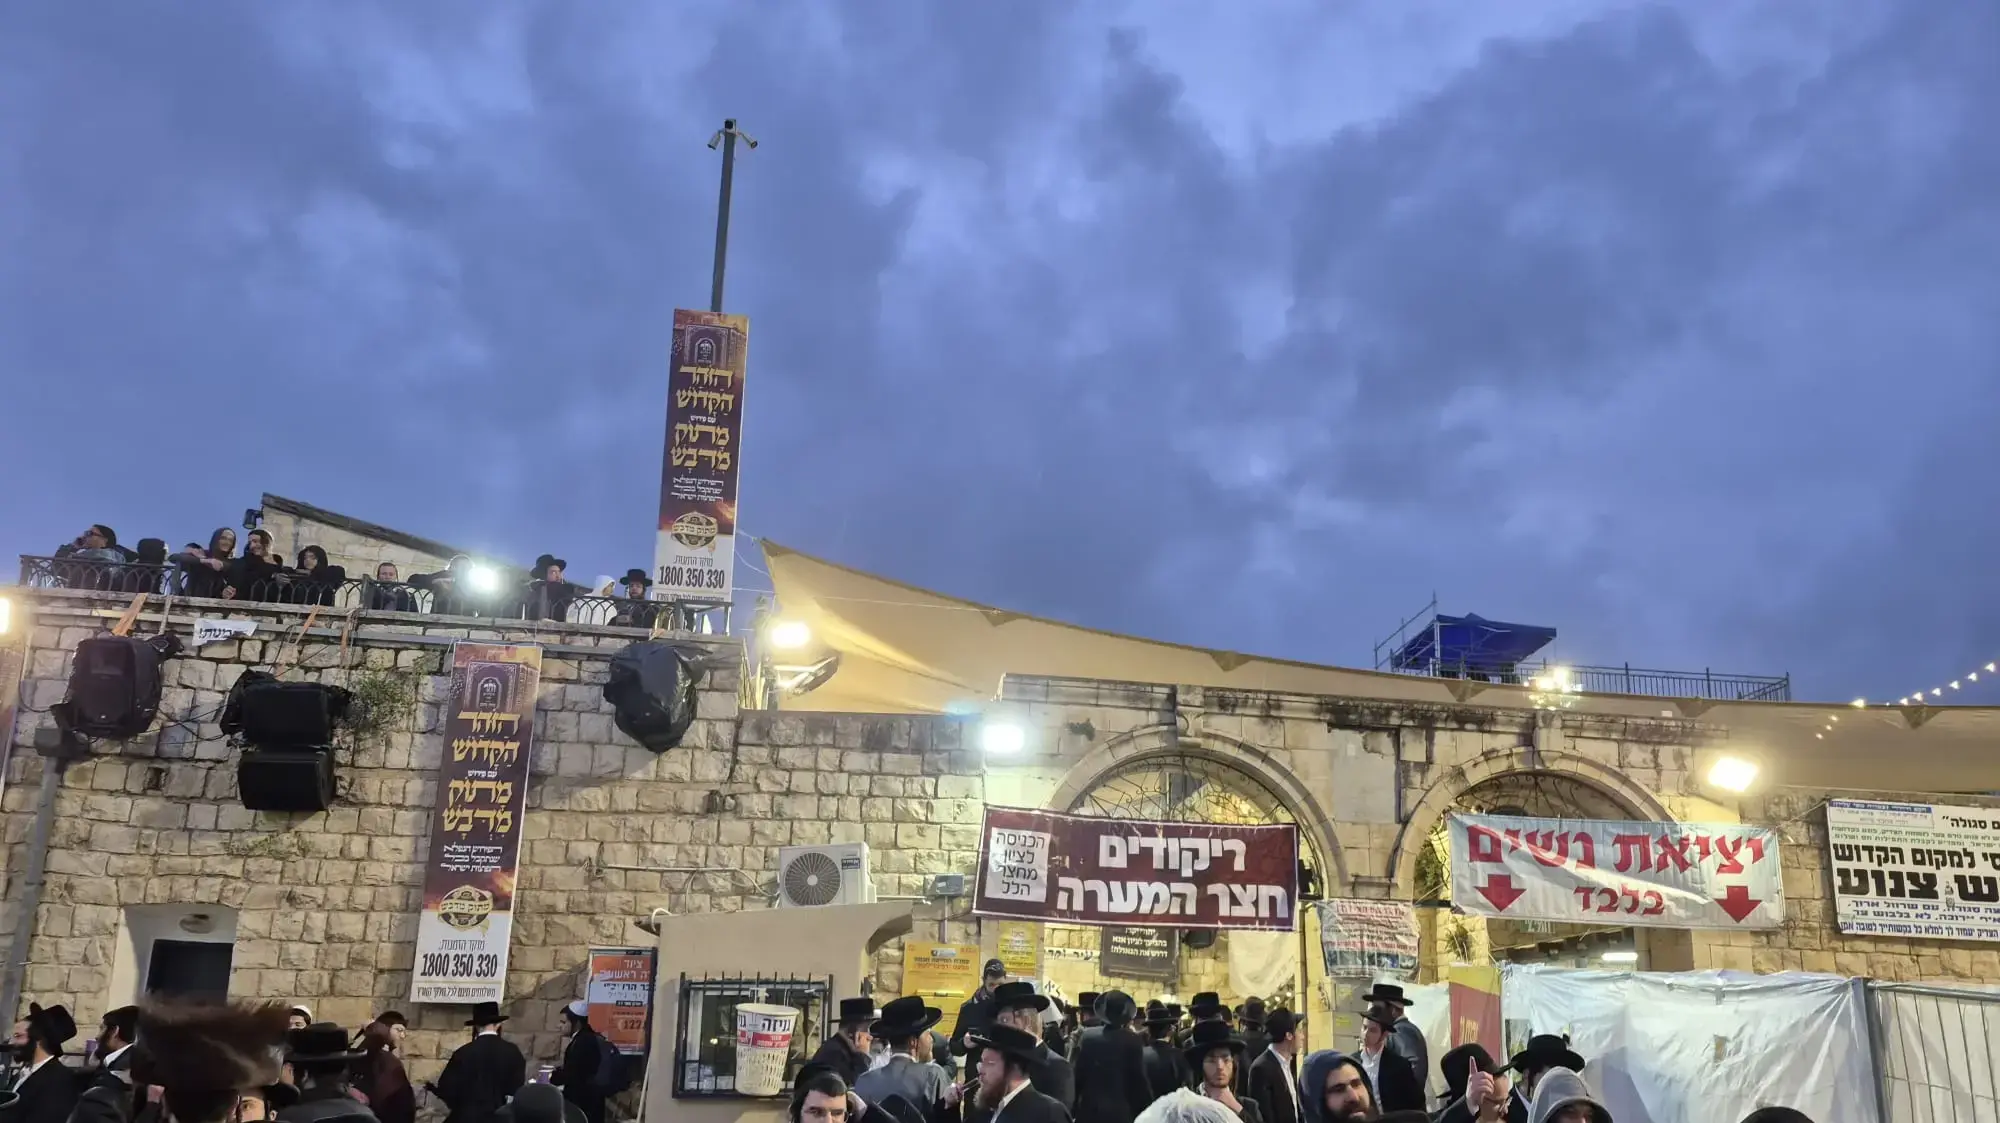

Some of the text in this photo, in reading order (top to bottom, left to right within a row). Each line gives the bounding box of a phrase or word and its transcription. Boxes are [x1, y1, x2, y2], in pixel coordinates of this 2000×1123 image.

[658, 565, 725, 589] 1800 350 330
[996, 832, 1045, 849] הכניסה
[1466, 824, 1766, 875] יציאת נשים
[1004, 849, 1035, 864] לציון
[1099, 834, 1247, 878] ריקודים
[1832, 843, 1905, 867] הקדוש
[1911, 848, 1976, 870] למקום
[998, 865, 1038, 880] מחצר
[1836, 868, 1939, 900] צנוע
[1002, 880, 1030, 896] הלל
[1056, 877, 1289, 919] חצר המערה
[1573, 883, 1665, 916] בלבד
[420, 953, 498, 978] 1800 350 330
[762, 1018, 791, 1032] גניזה
